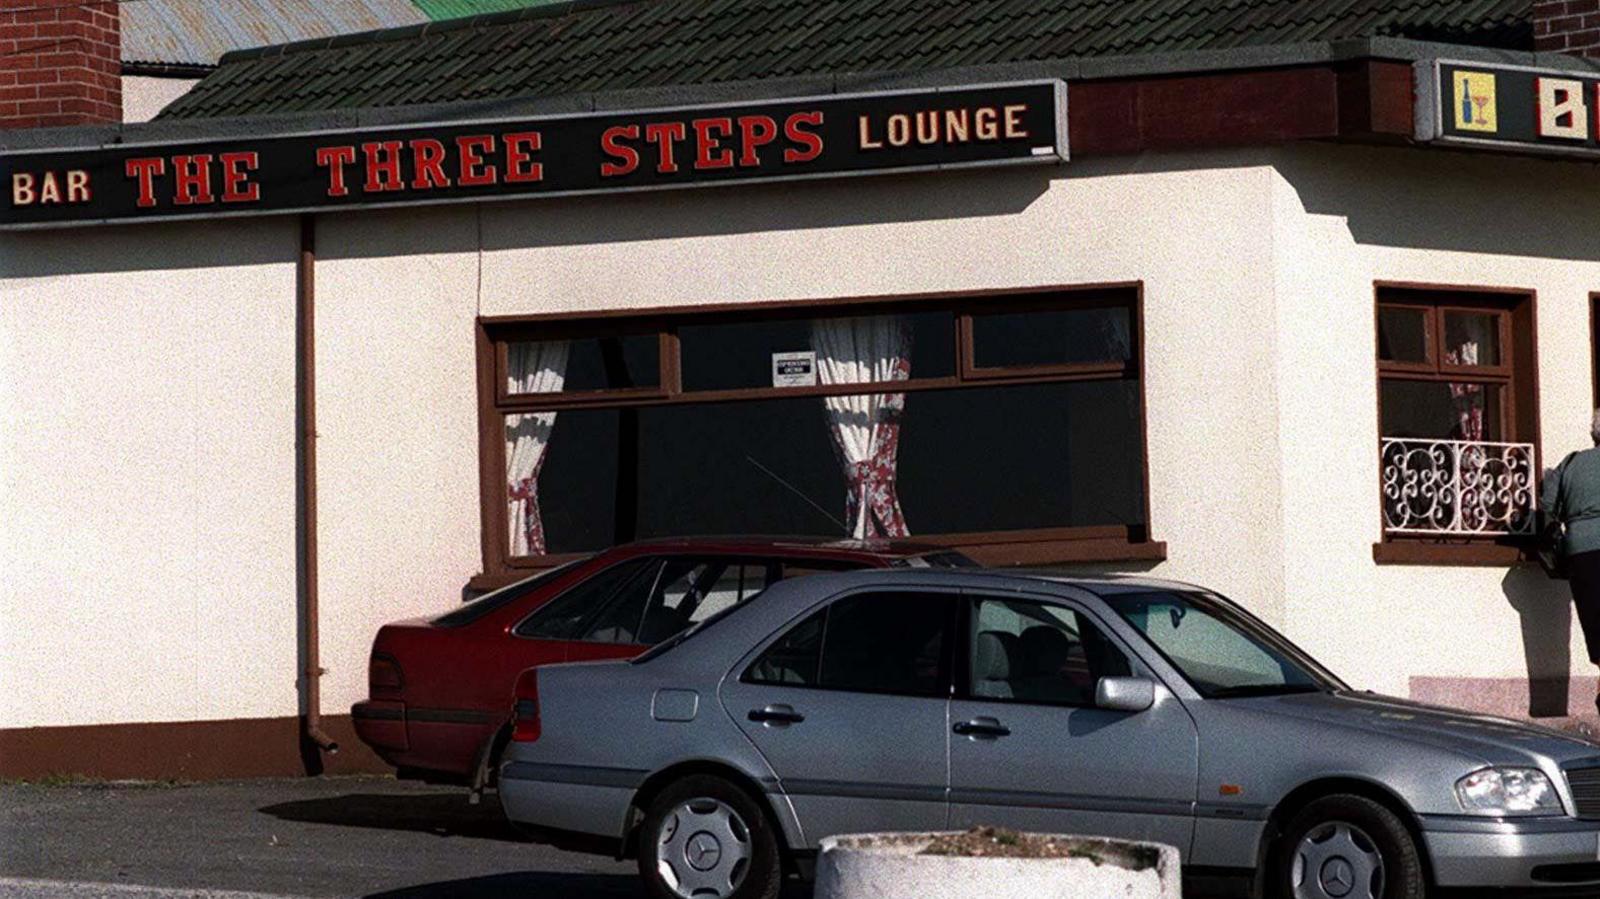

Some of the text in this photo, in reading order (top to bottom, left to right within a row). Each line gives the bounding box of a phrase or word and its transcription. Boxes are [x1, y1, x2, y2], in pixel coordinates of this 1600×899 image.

[1537, 77, 1600, 141] B
[12, 104, 1028, 207] BAR THE THREE STEPS LOUNGE
